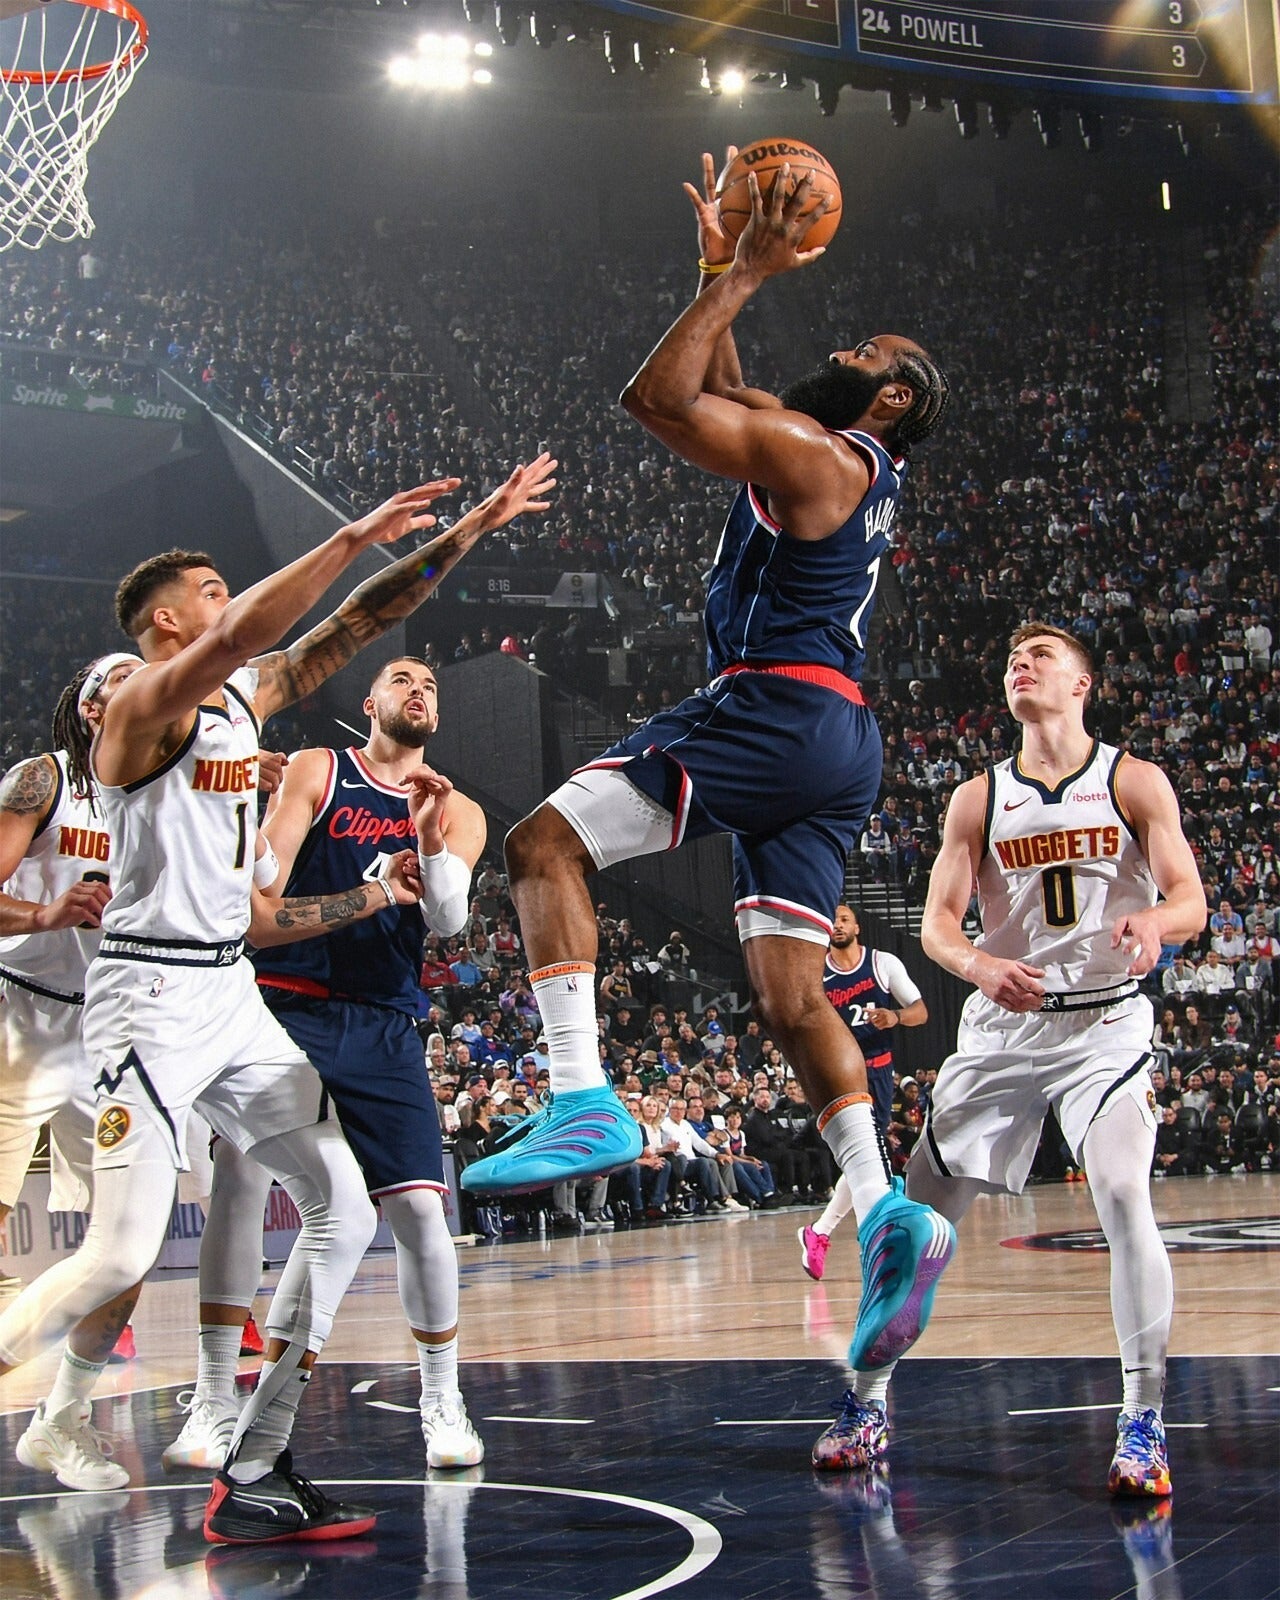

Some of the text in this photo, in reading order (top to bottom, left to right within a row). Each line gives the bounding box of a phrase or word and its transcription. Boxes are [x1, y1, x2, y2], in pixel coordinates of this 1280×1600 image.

[1168, 1, 1183, 25] 3
[861, 7, 1186, 68] 24 POWELL 3
[742, 143, 827, 167] Wilson
[12, 384, 69, 407] Sprite
[133, 398, 187, 420] Sprite
[1072, 791, 1109, 803] ibotta
[233, 801, 249, 870] 1
[328, 805, 419, 846] Clipper
[994, 825, 1120, 870] NUGGETS
[1041, 865, 1078, 929] 0
[48, 1210, 92, 1251] PLA
